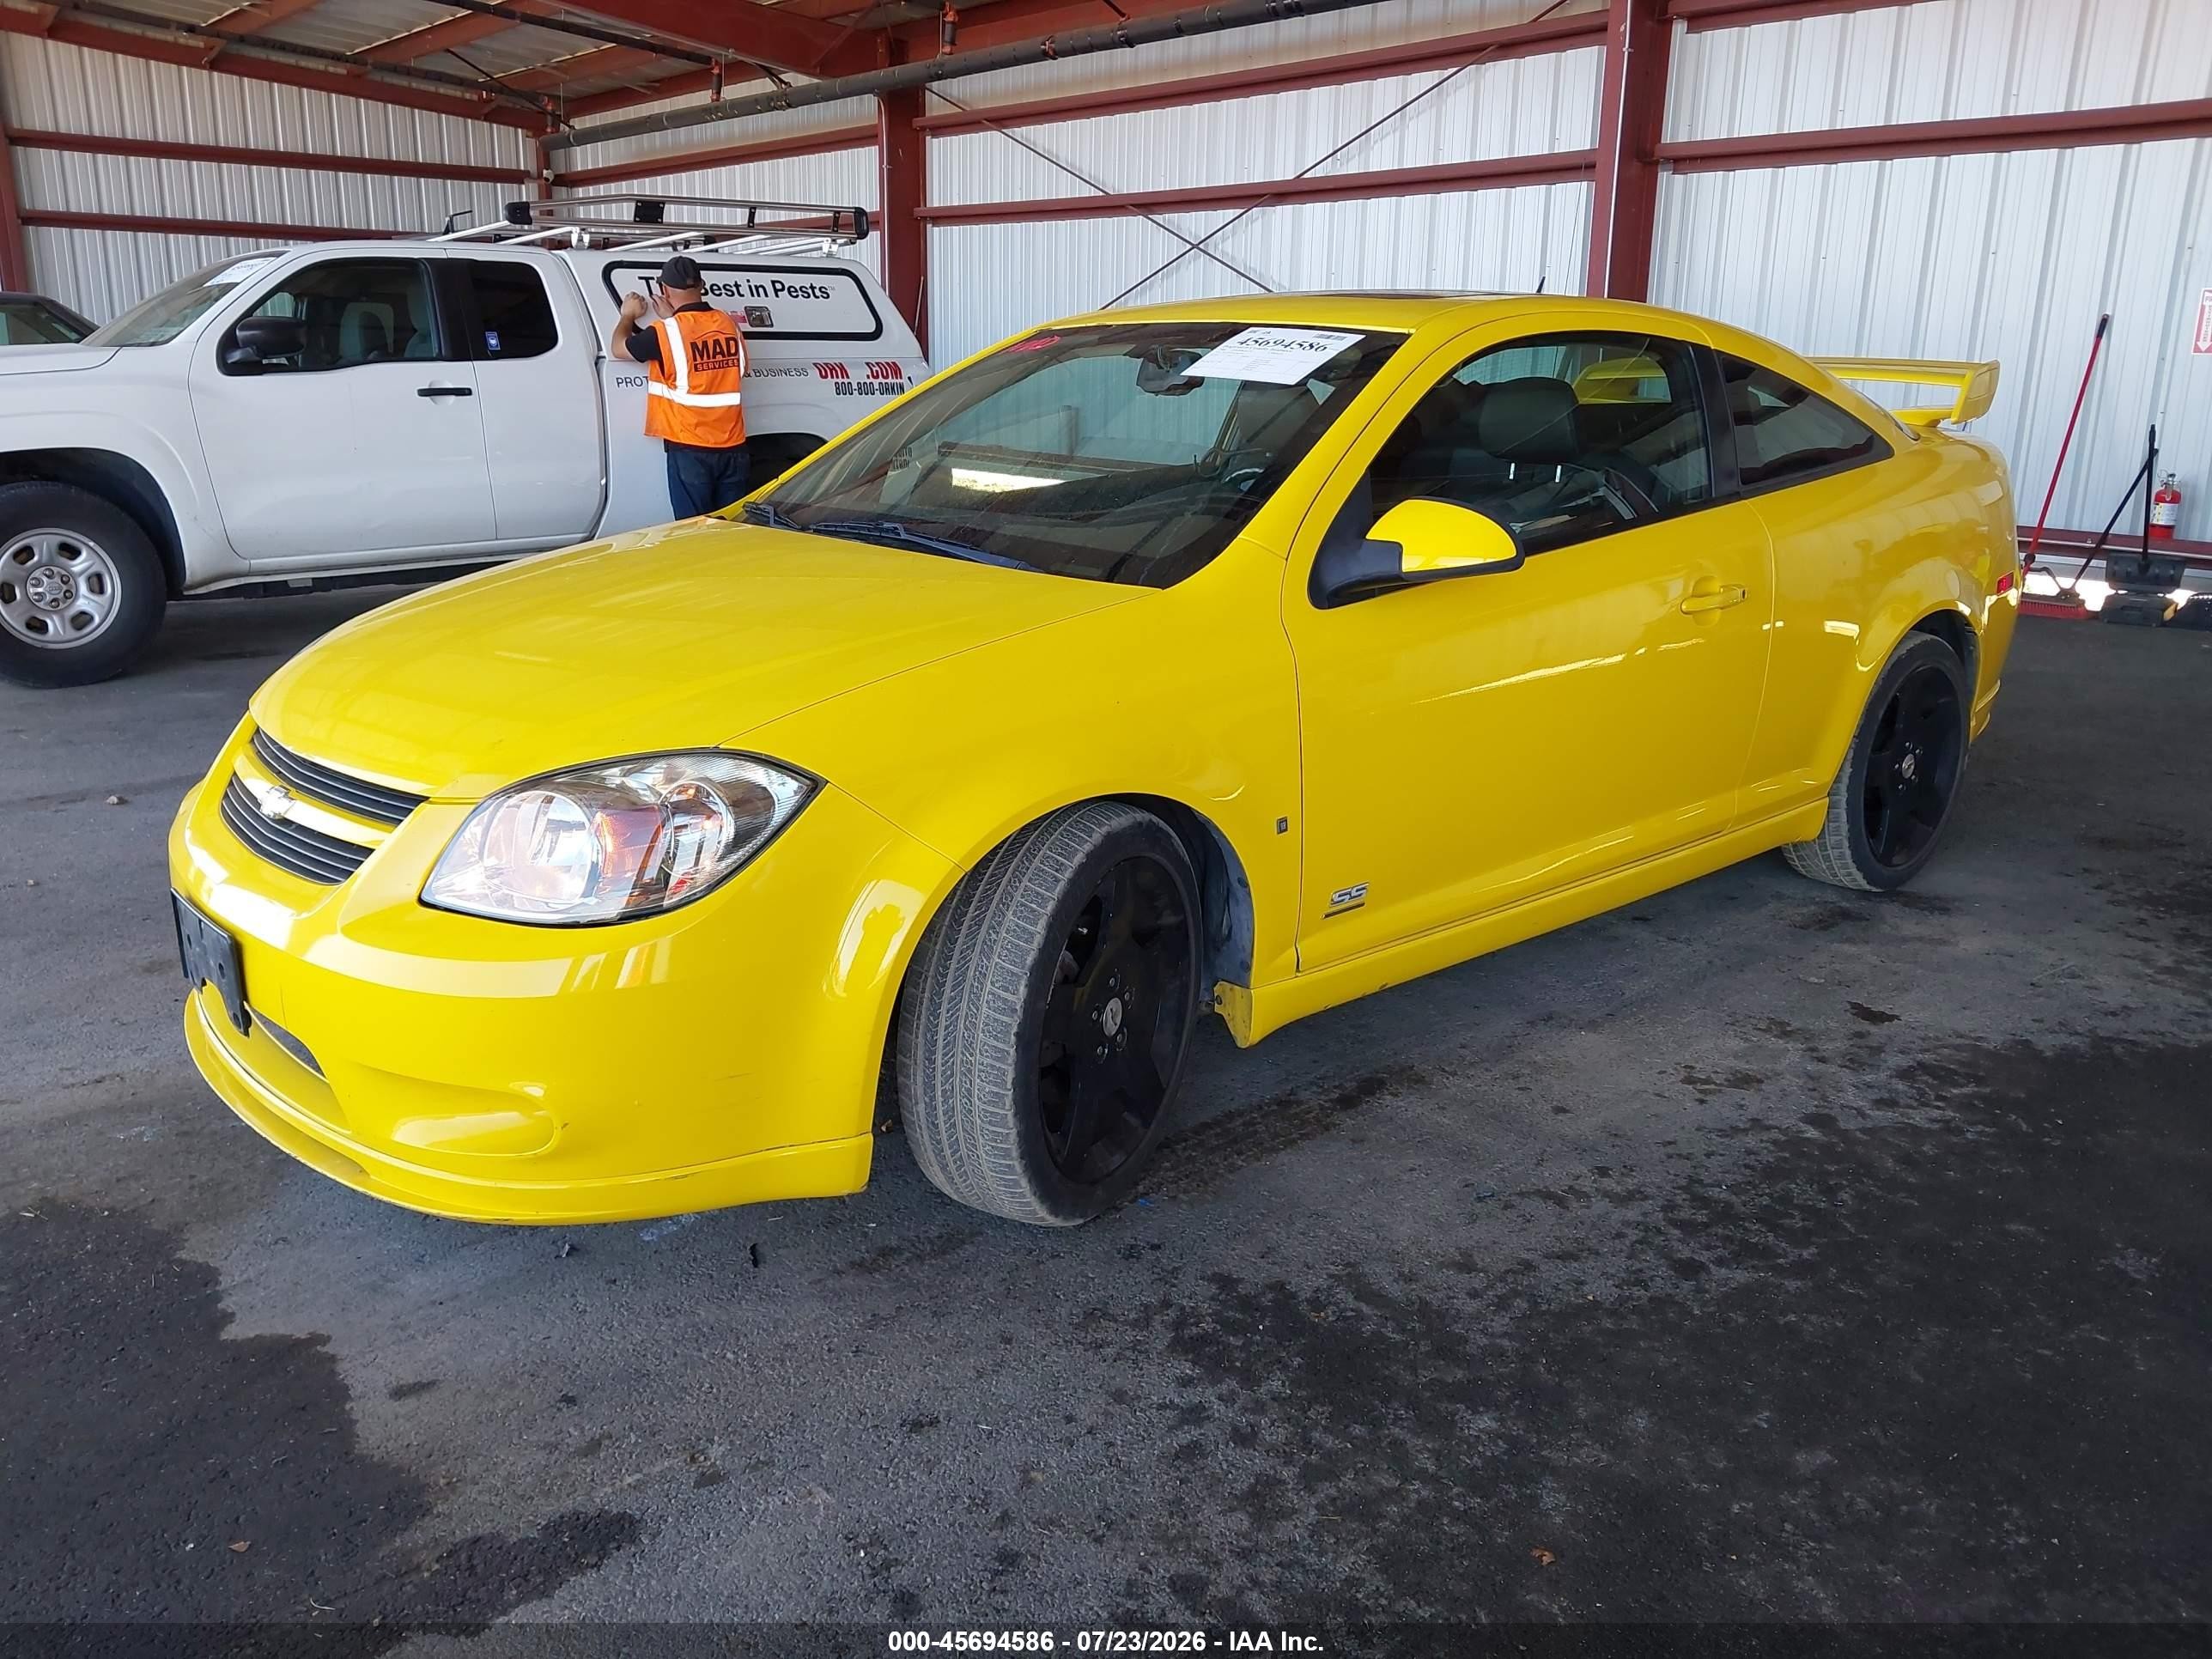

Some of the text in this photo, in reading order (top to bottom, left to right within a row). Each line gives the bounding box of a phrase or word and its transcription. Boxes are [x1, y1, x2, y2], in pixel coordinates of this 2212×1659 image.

[746, 278, 769, 297] in
[690, 337, 738, 362] MAD
[1237, 336, 1330, 353] 45694586
[696, 359, 738, 371] SERVICES
[752, 368, 809, 378] BUSINESS
[835, 381, 905, 396] 800-800-ORKIN
[1329, 883, 1369, 907] SS
